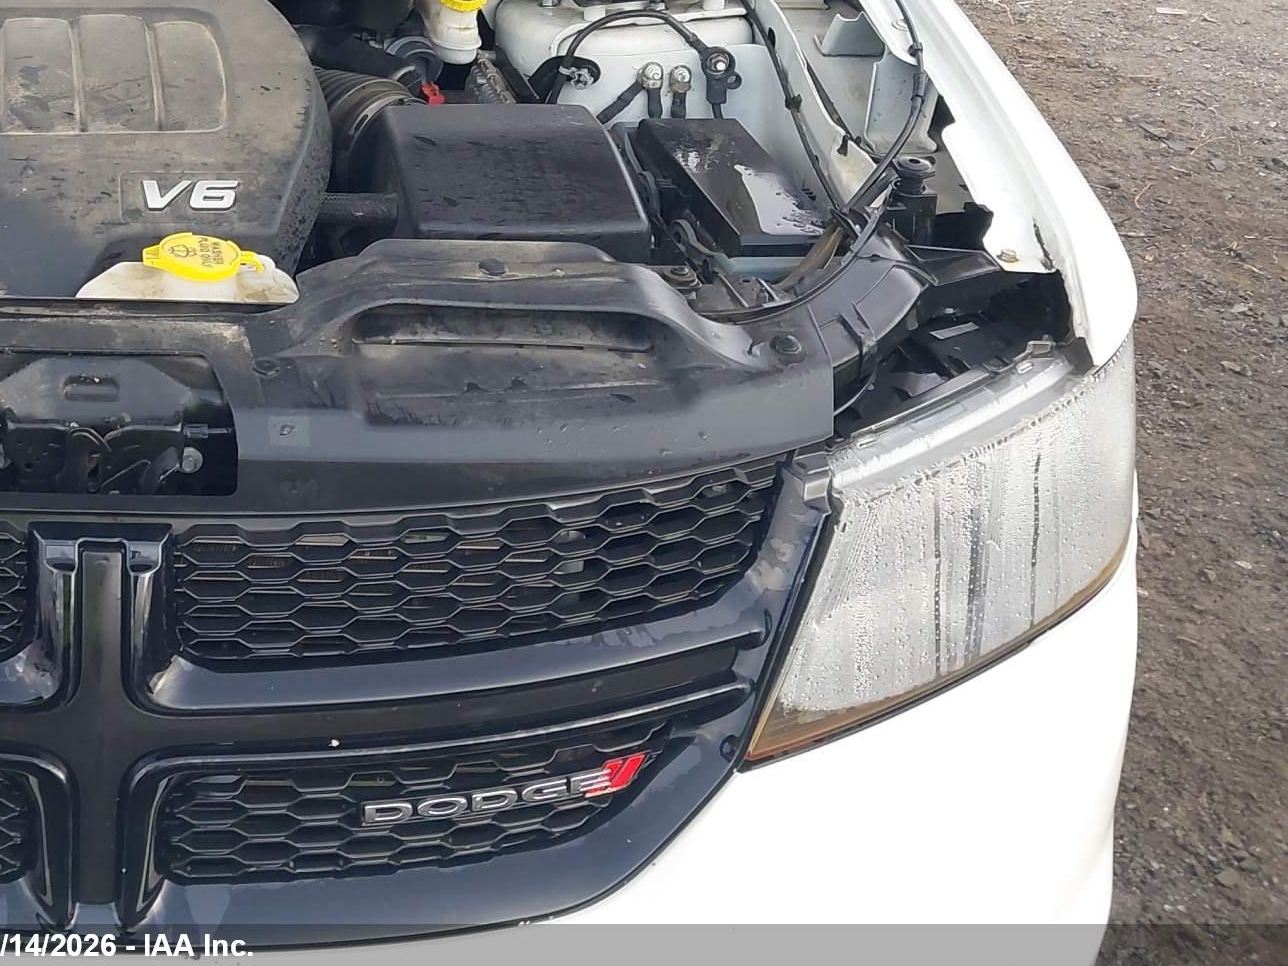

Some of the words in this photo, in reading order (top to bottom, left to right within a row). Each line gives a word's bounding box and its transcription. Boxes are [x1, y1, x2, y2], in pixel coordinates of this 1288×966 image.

[142, 180, 239, 211] V6
[212, 241, 224, 265] WASHER
[364, 769, 611, 824] DODGE
